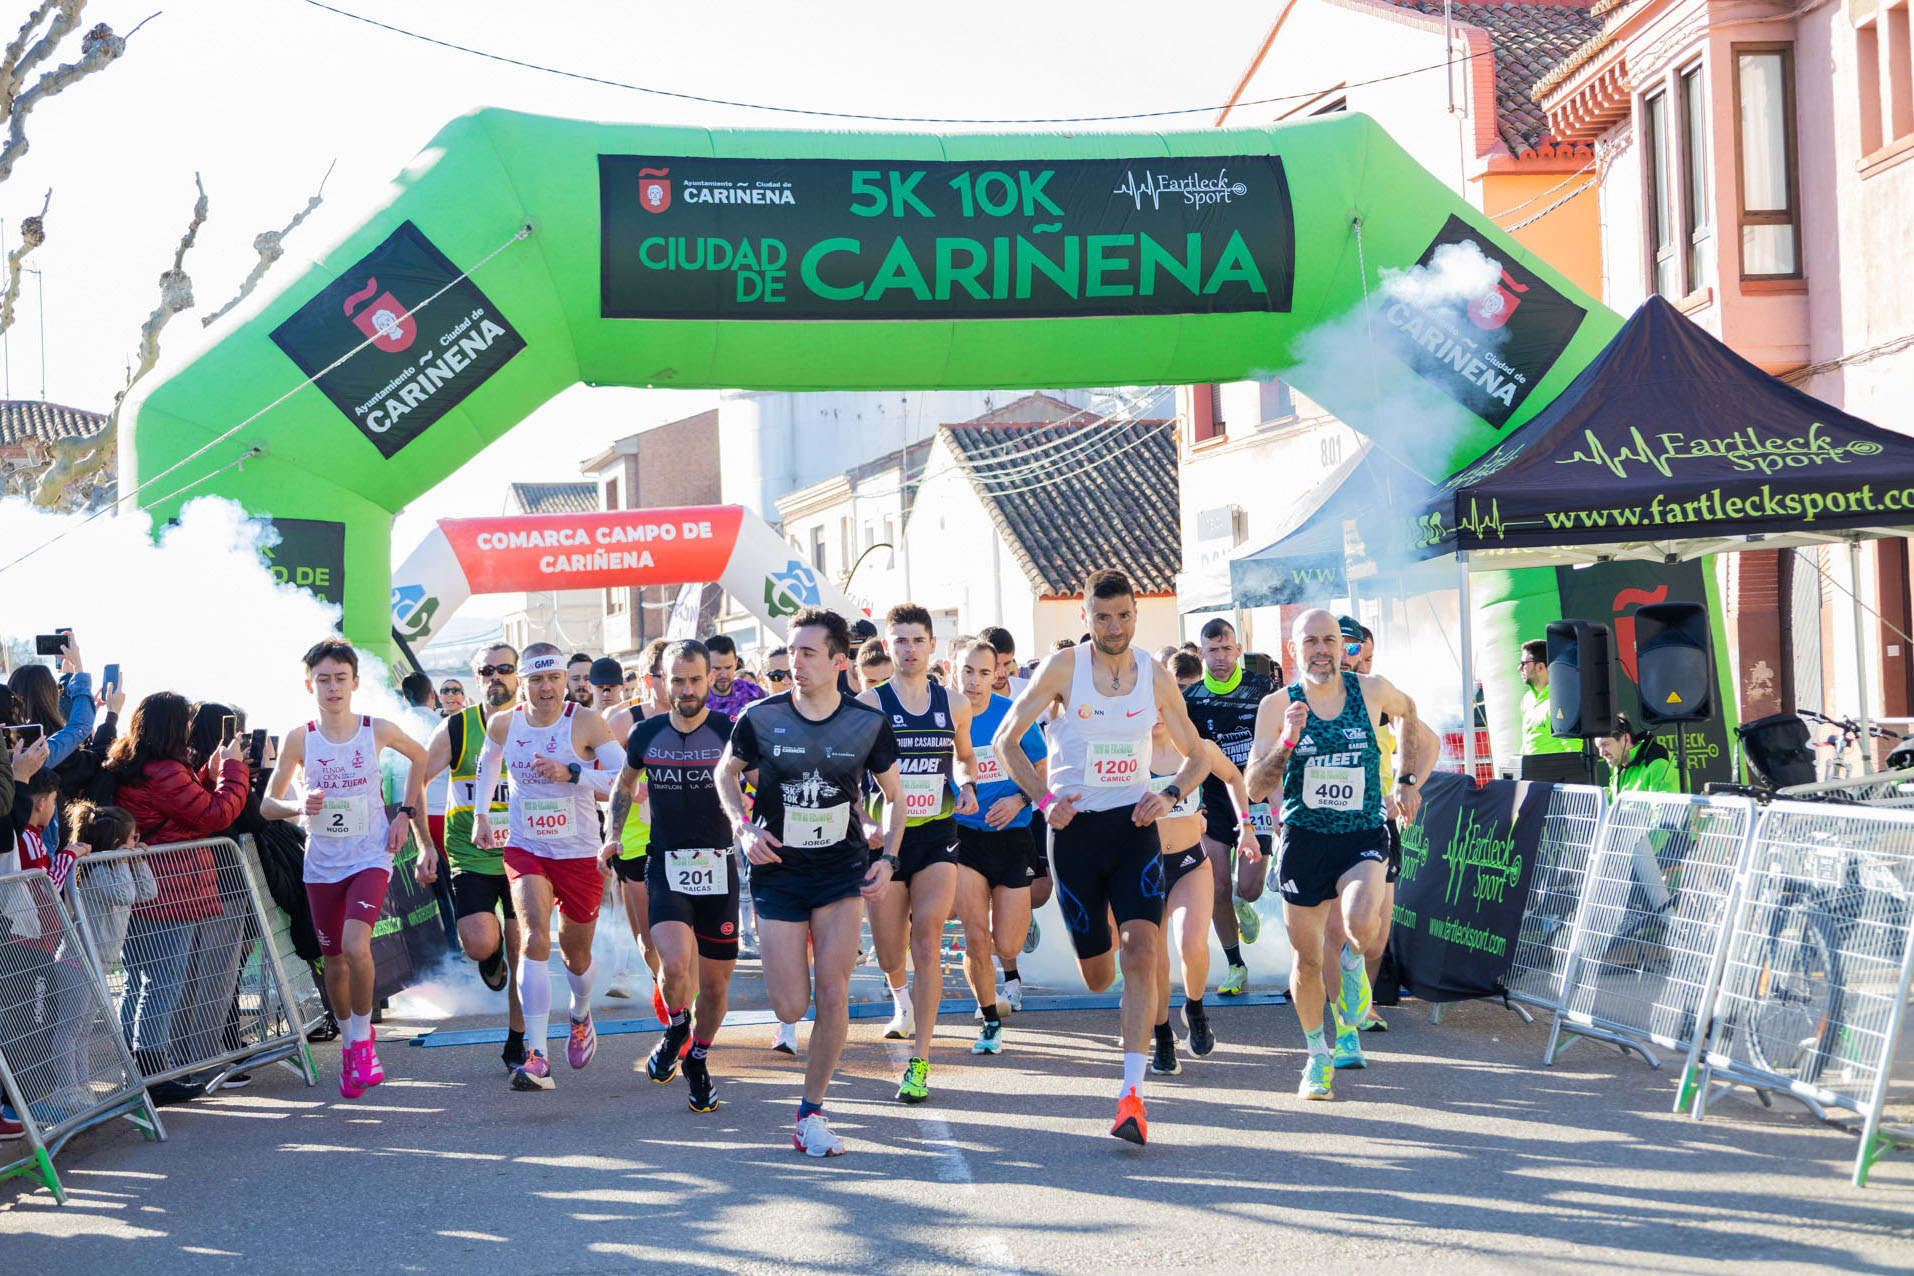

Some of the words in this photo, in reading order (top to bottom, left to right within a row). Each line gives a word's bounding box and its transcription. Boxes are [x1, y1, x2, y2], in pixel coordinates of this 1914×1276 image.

[683, 180, 733, 188] Ayuntamiento
[1157, 168, 1229, 191] Fartleck
[848, 170, 936, 217] 5K
[948, 170, 1065, 217] 10K
[1184, 188, 1232, 211] Sport
[638, 236, 788, 271] CIUDAD
[800, 222, 1268, 302] CARIÑENA
[736, 270, 787, 302] DE
[354, 365, 416, 417] Ayuntamiento
[439, 317, 472, 347] Ciudad
[471, 307, 485, 322] de
[1484, 351, 1515, 376] Ciudad
[1514, 372, 1527, 384] de
[1656, 422, 1832, 456] Fartleck
[1727, 448, 1852, 475] Sport
[476, 526, 590, 552] COMARCA
[594, 523, 677, 545] CAMPO
[681, 521, 713, 540] DE
[539, 548, 655, 575] CARIÑENA
[296, 566, 330, 586] DE
[534, 658, 555, 669] GMP
[896, 758, 940, 773] MAPEI
[978, 760, 998, 773] 02
[1094, 759, 1138, 774] 1200
[1304, 751, 1362, 768] ATLEET
[342, 777, 368, 788] ZUERA
[648, 768, 682, 783] MAI
[686, 769, 713, 782] CA
[783, 794, 798, 804] 10K
[906, 793, 935, 807] 000
[1315, 783, 1353, 800] 400
[332, 813, 344, 827] 2
[527, 813, 567, 828] 1400
[1249, 815, 1273, 826] 210
[536, 828, 559, 836] DENIS
[813, 826, 823, 839] 1
[802, 838, 831, 846] JORGE
[678, 869, 713, 886] 201
[1429, 915, 1507, 958] www.fartlecksport.com
